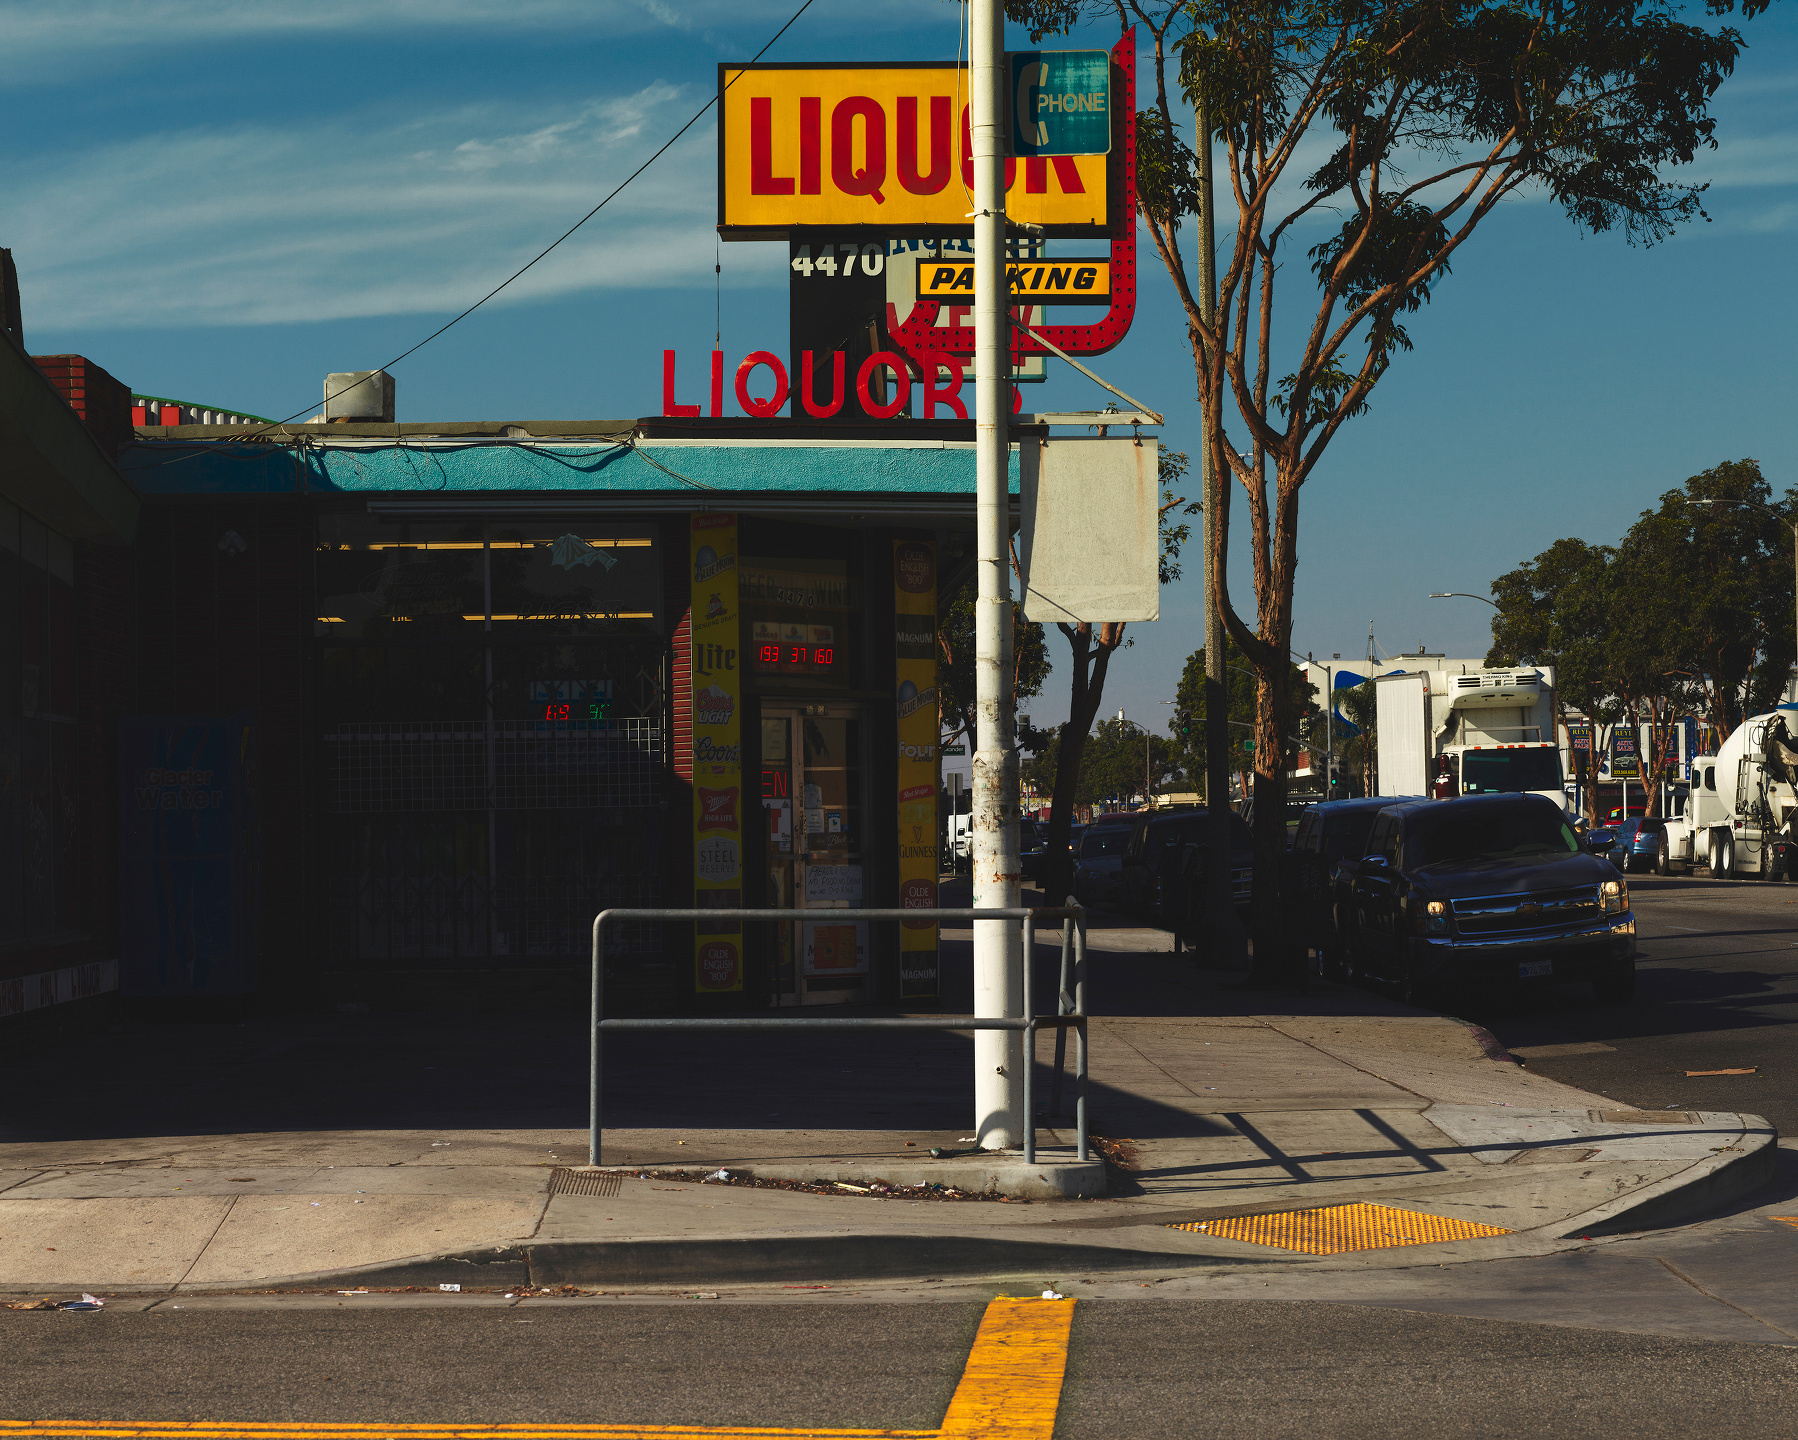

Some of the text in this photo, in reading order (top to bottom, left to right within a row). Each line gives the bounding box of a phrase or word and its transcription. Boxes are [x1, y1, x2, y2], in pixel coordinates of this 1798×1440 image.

[1037, 92, 1106, 113] PHONE
[791, 243, 884, 277] 4470
[929, 267, 1098, 290] PAKING
[663, 349, 1022, 420] LIQUOR
[904, 549, 925, 561] OLDE
[695, 555, 735, 582] BLUE MOON
[900, 560, 929, 573] ENGLISH
[777, 589, 814, 607] 4470
[694, 619, 719, 631] GENUINE
[720, 613, 737, 623] DRAFT
[896, 631, 933, 643] MAGNUM
[695, 643, 736, 676] Lite
[760, 645, 779, 662] 193
[791, 647, 807, 663] 37
[814, 648, 833, 664] 160
[696, 687, 736, 713] Coors
[898, 689, 935, 719] BLUE MOON
[697, 711, 733, 725] LIGHT
[898, 740, 936, 758] four
[145, 767, 213, 786] Glacier
[135, 786, 223, 810] Water
[705, 795, 732, 812] Miller
[720, 814, 733, 822] LIFE
[700, 850, 735, 863] STEEL
[899, 844, 937, 858] GUINNESS
[700, 864, 735, 873] RESERVE
[908, 886, 929, 897] OLDE
[905, 897, 933, 909] ENGLISH
[708, 948, 729, 959] OLDE
[704, 959, 734, 971] ENGLISH
[901, 968, 936, 980] MAGNUM
